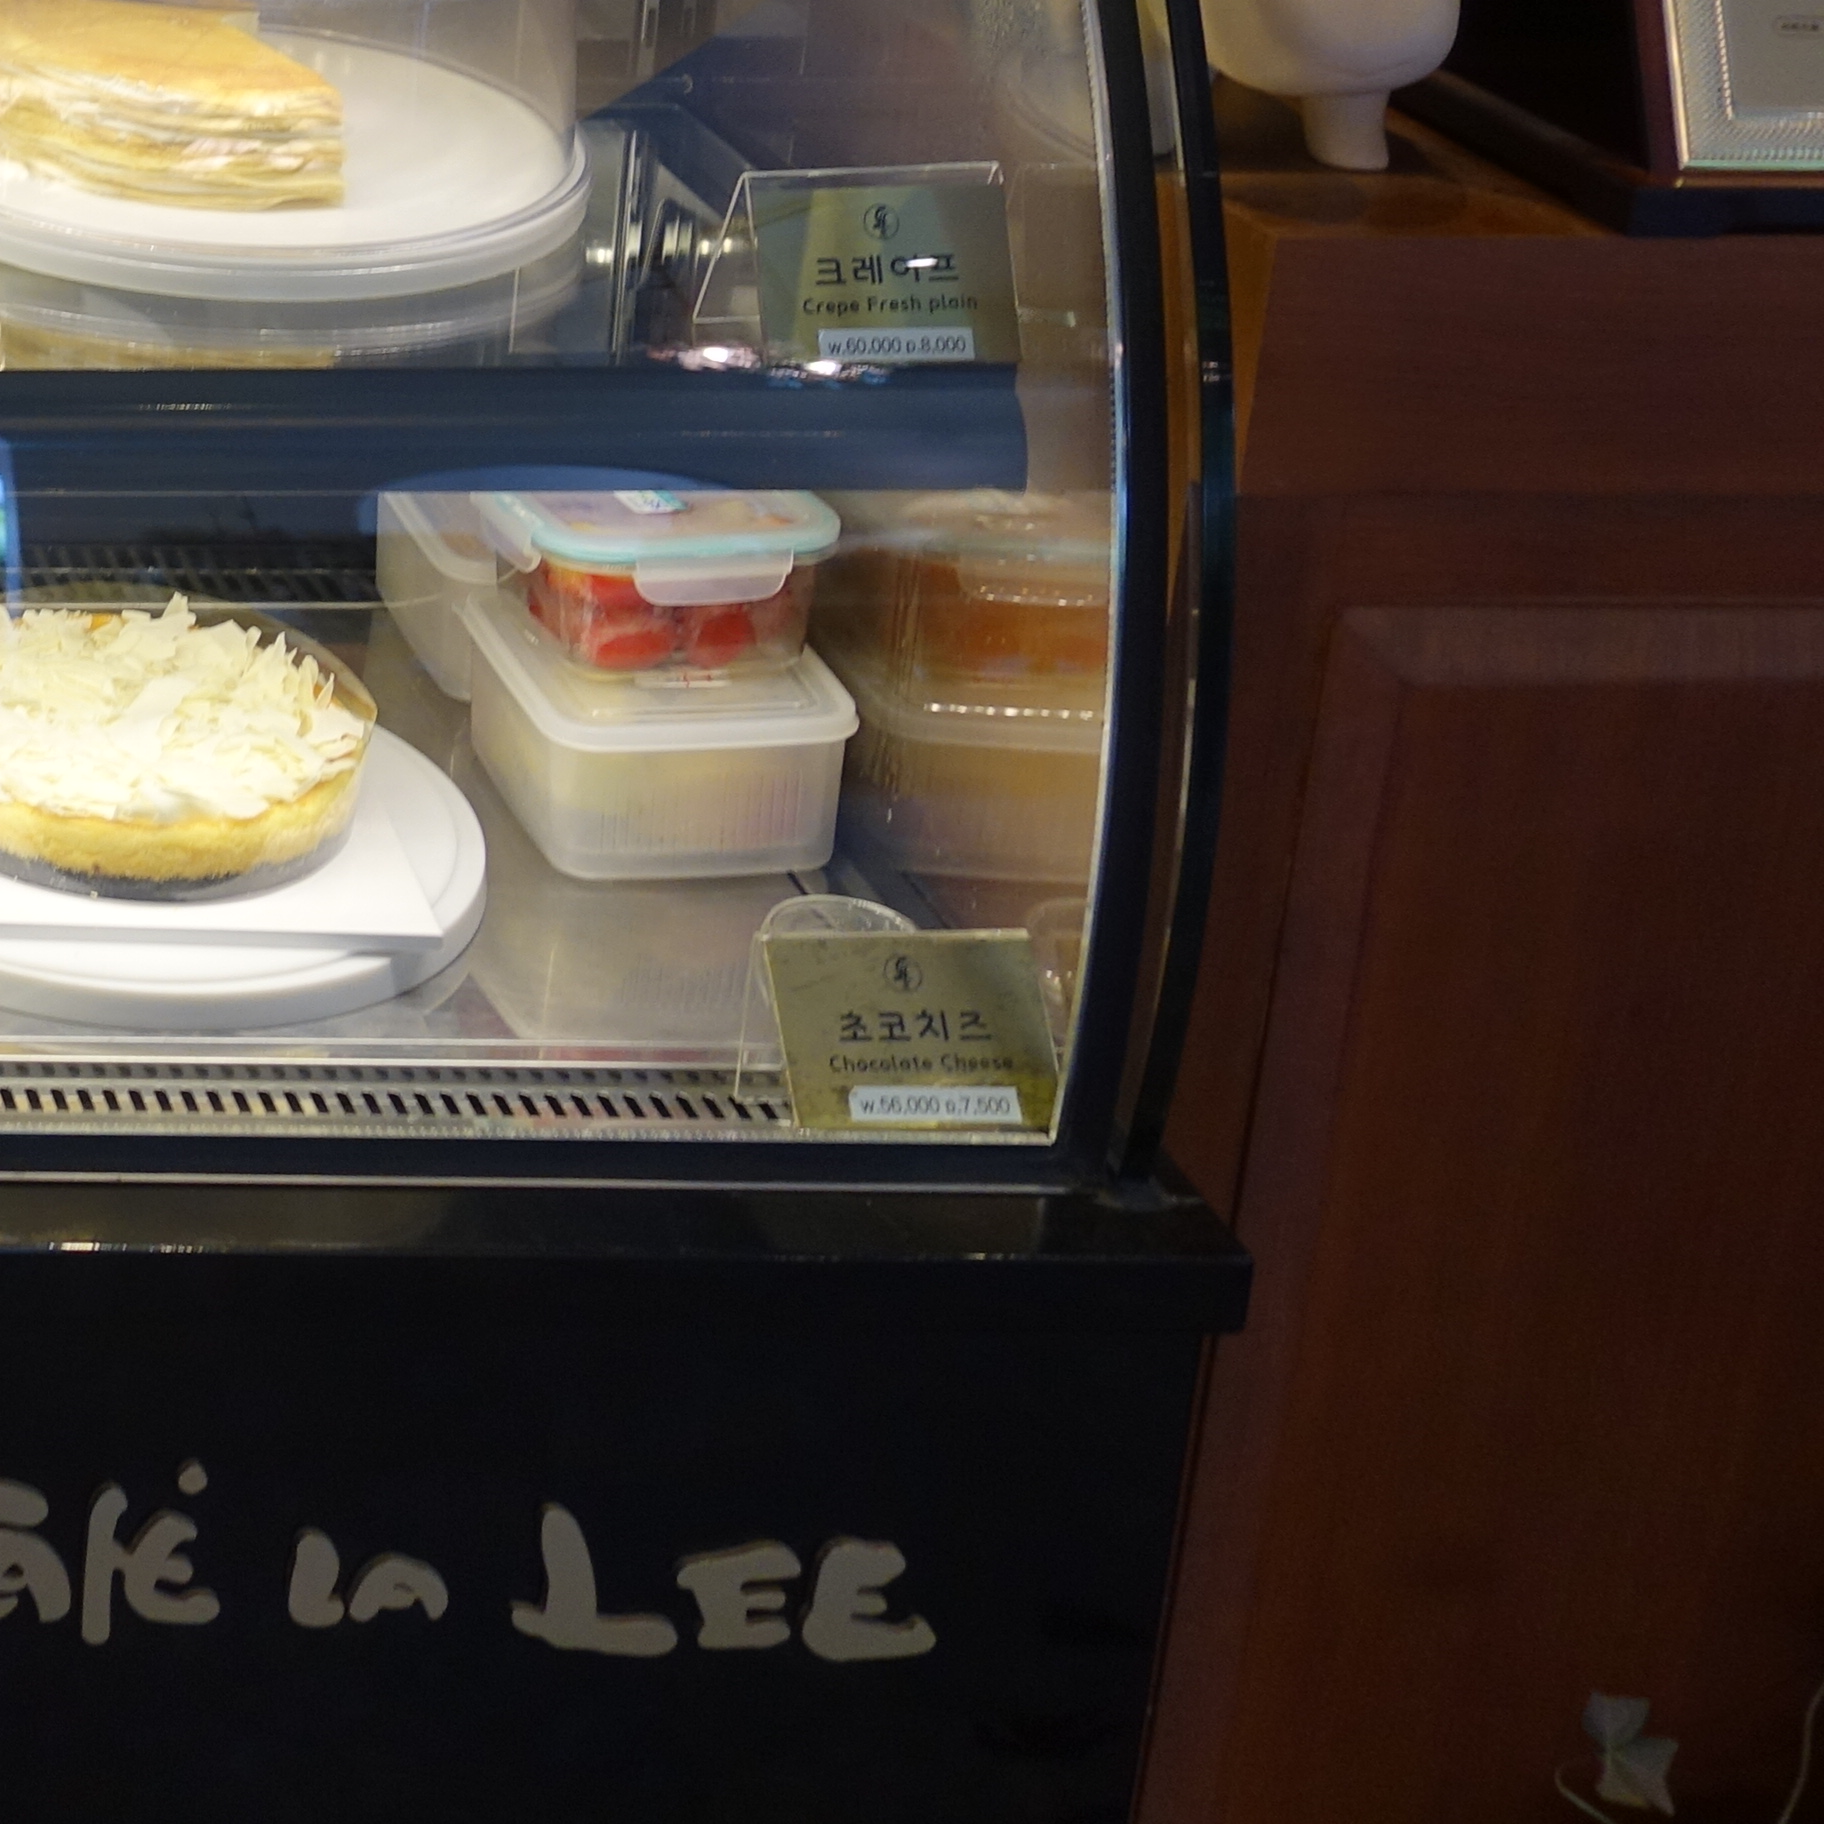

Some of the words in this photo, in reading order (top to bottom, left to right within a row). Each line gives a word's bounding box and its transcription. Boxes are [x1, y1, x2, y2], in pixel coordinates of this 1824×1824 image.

[803, 298, 859, 316] Crepe
[867, 296, 921, 312] Fresh
[929, 294, 978, 313] plain
[839, 1009, 993, 1041] 초코치즈
[830, 1055, 933, 1072] Chocolate
[941, 1055, 1013, 1071] Cheese
[511, 1502, 938, 1663] LEE
